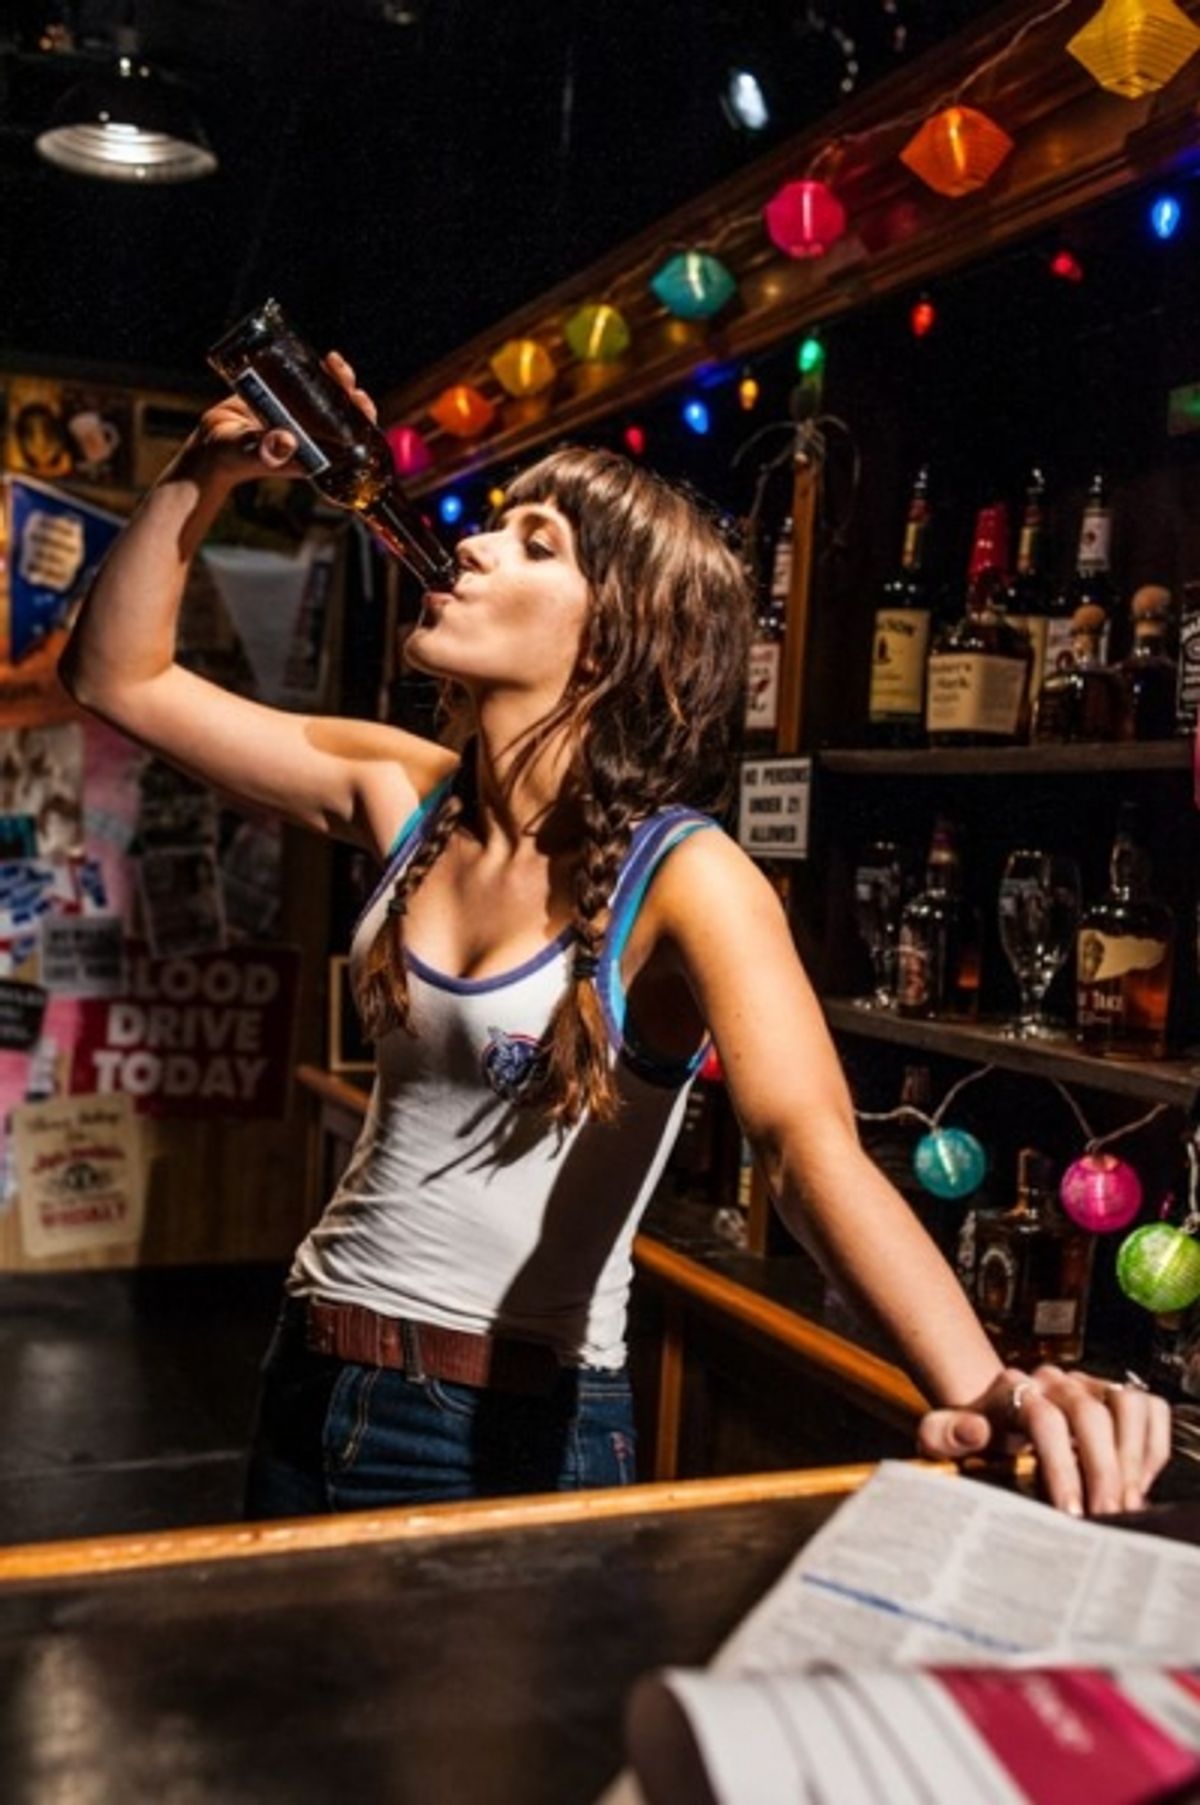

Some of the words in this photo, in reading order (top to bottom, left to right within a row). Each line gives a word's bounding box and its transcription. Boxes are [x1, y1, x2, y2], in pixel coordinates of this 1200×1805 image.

[129, 957, 281, 1001] LOOD
[107, 1003, 265, 1050] DRIVE
[92, 1049, 272, 1099] TODAY
